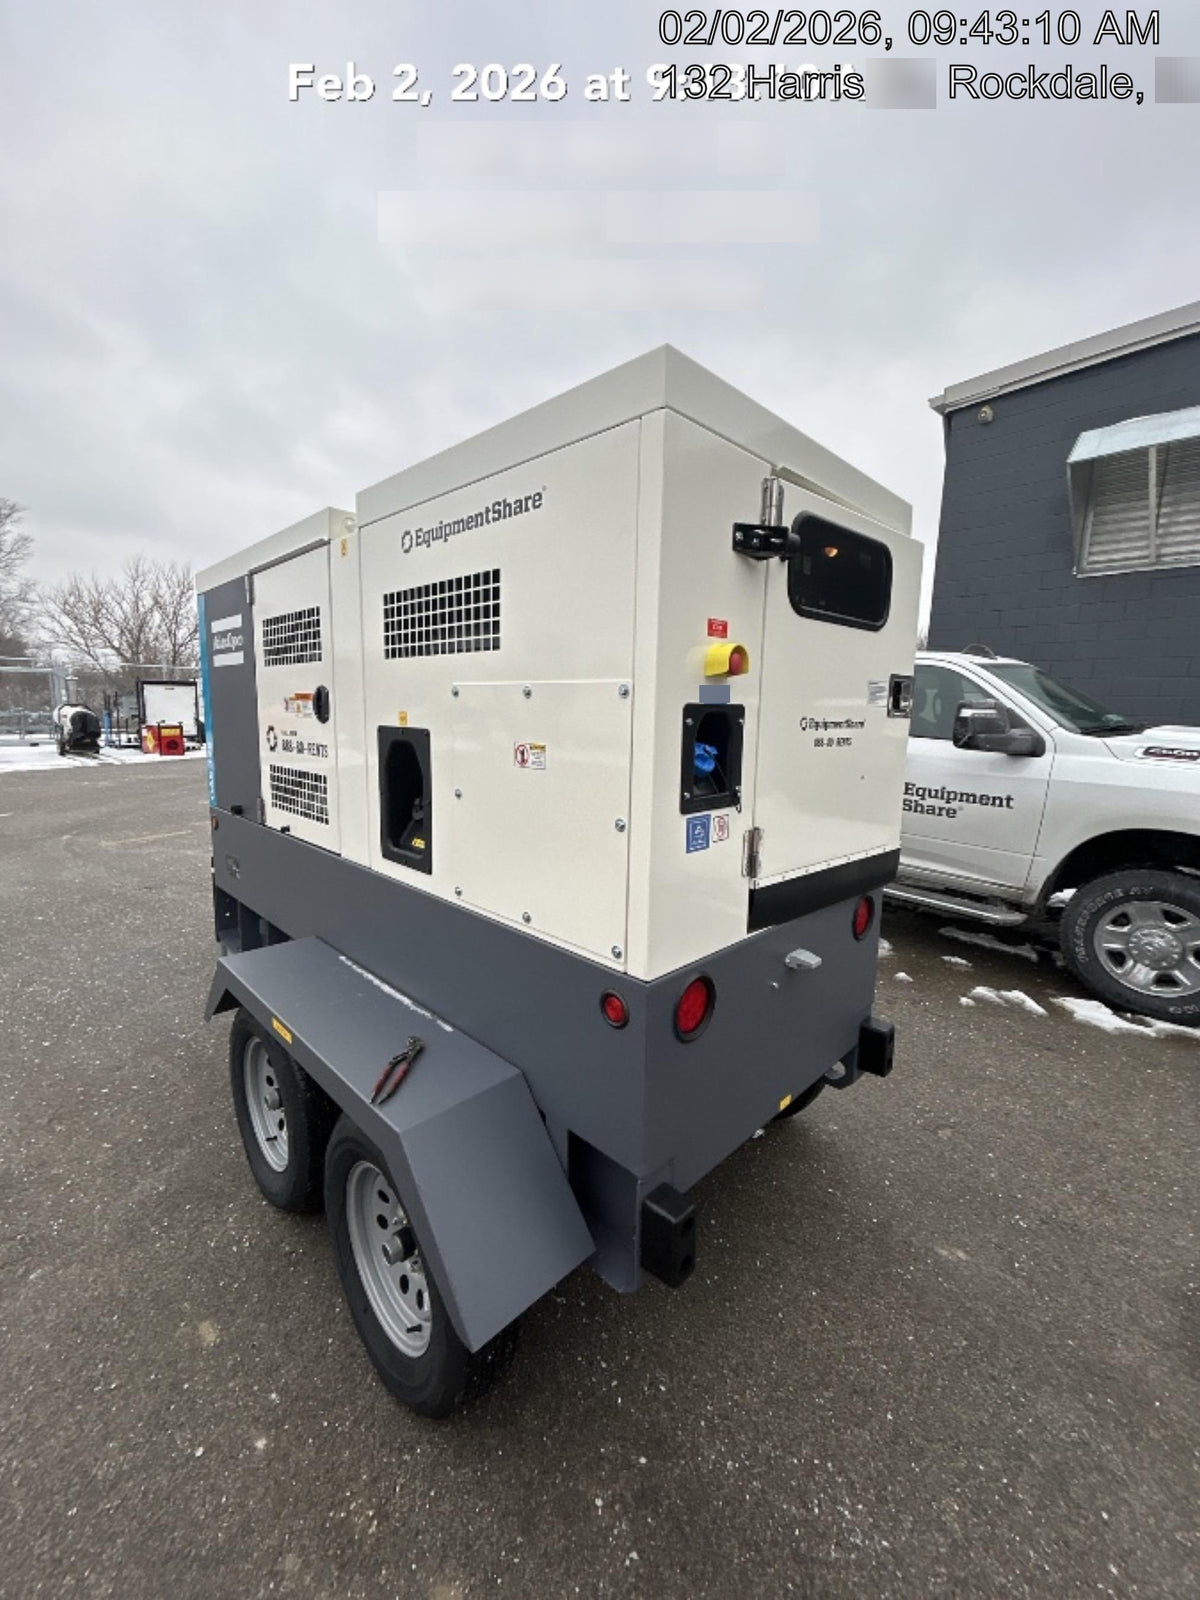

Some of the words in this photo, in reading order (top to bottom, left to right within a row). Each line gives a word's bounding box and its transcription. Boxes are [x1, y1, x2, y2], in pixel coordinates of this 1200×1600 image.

[415, 491, 543, 549] EquipmentShare
[902, 798, 957, 819] Share
[903, 782, 1015, 810] Equipment
